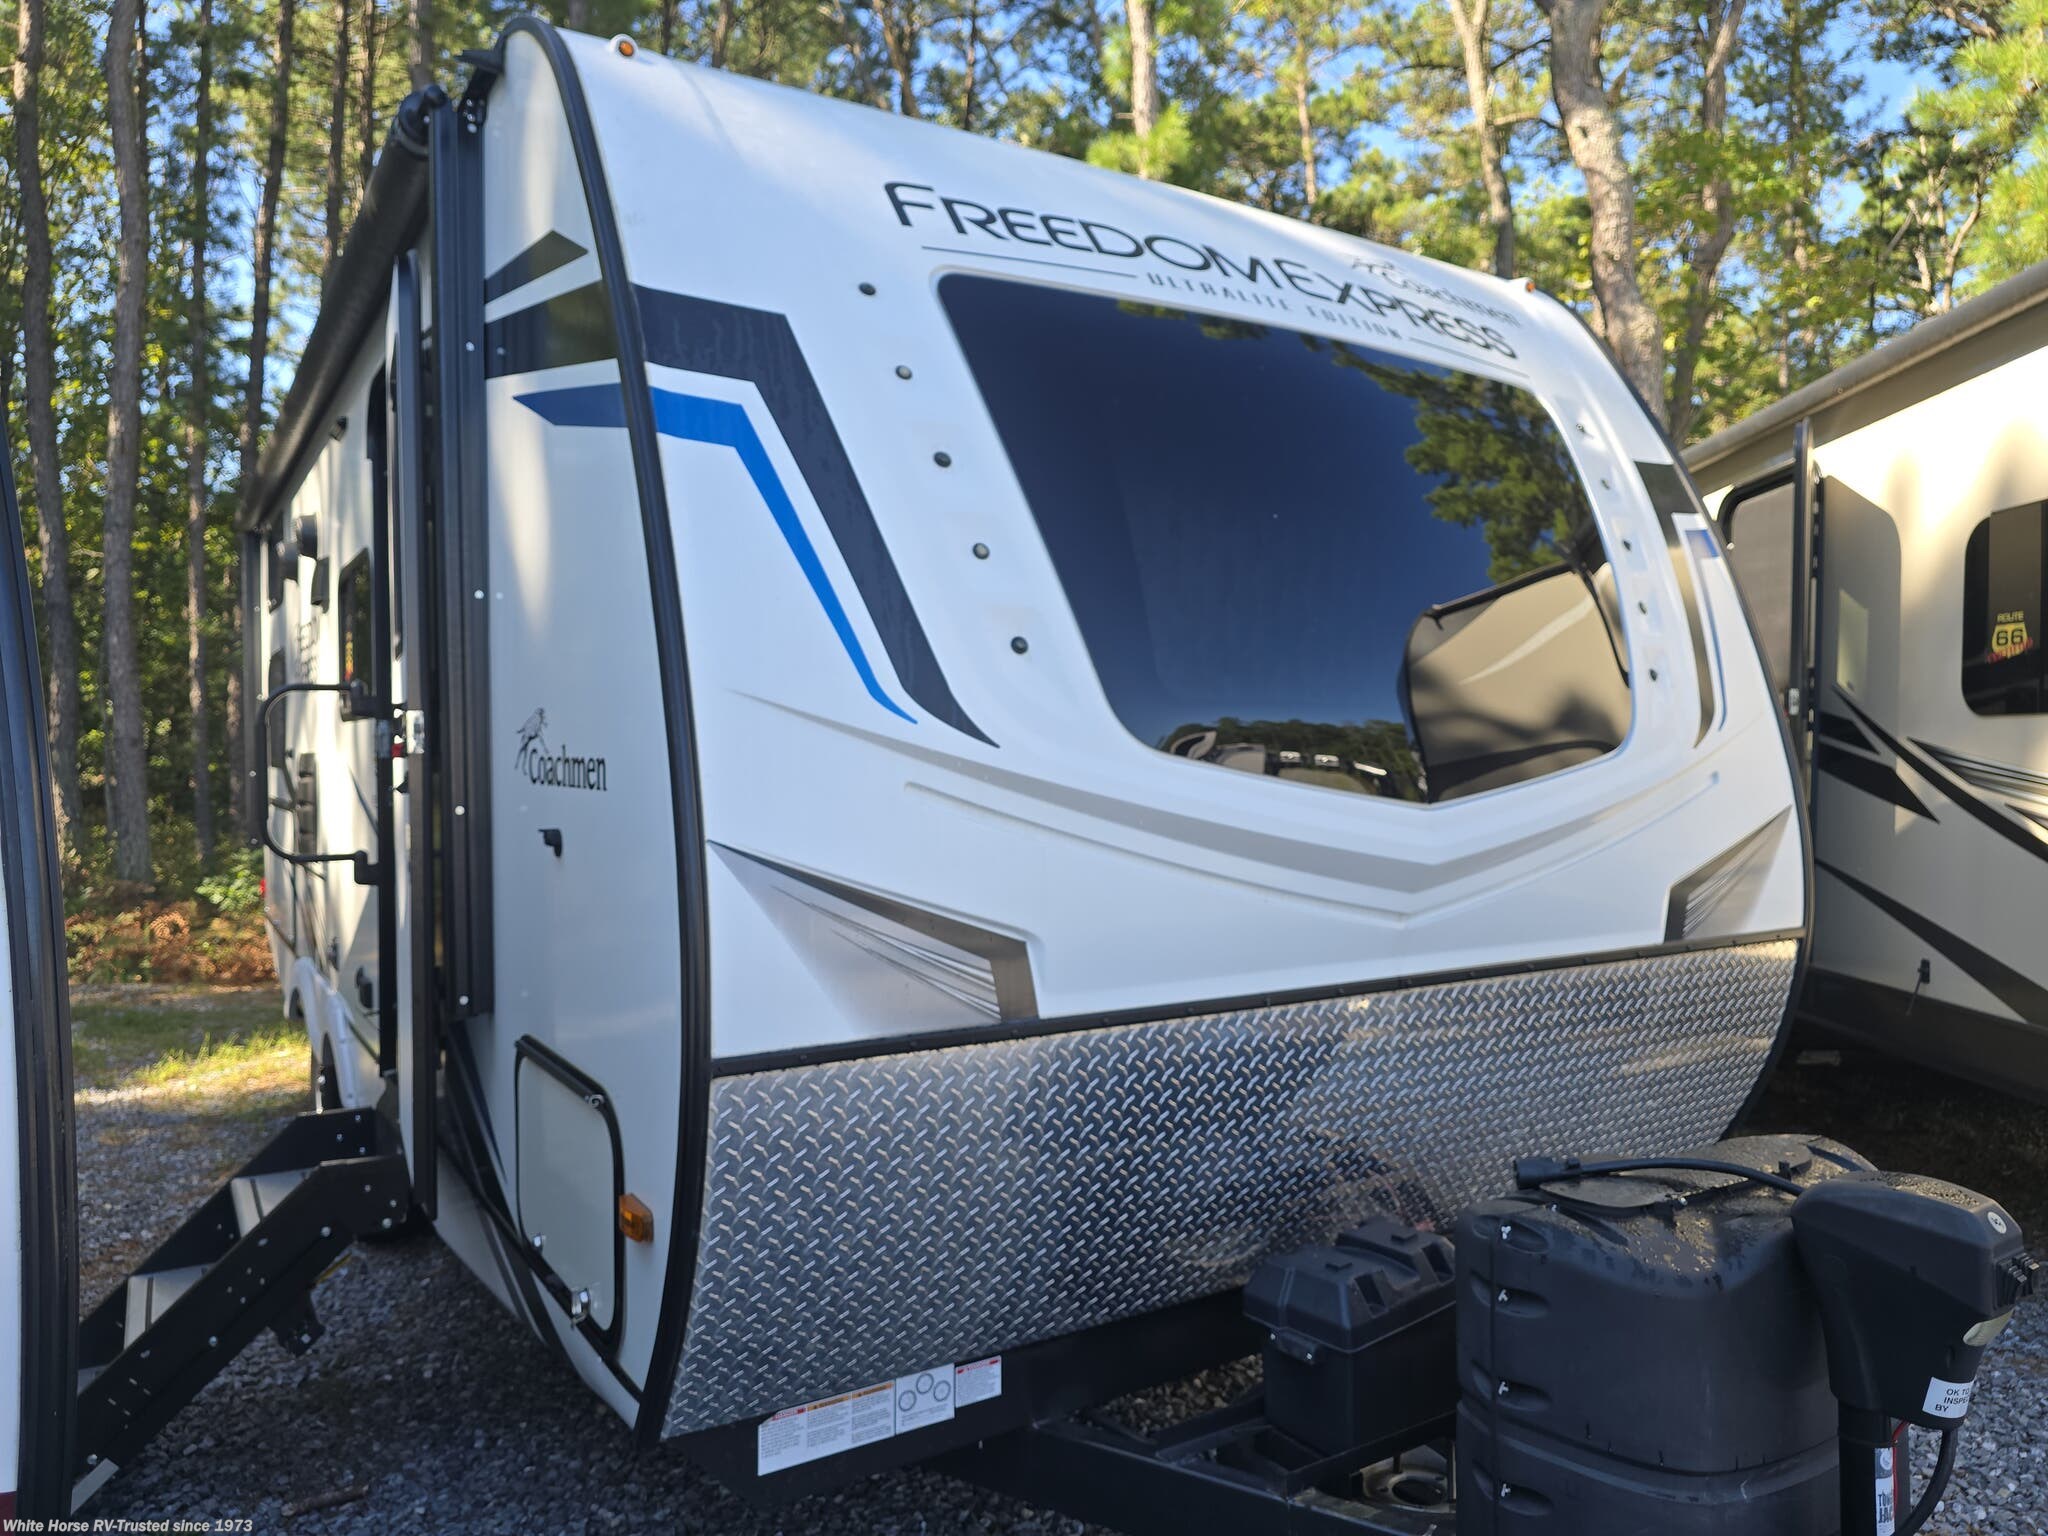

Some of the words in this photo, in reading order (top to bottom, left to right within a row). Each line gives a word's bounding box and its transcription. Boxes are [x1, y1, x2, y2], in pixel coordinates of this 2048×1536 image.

[1995, 628, 2024, 647] 66
[528, 743, 608, 792] Coachmen
[1946, 1388, 1960, 1396] OK
[1935, 1403, 1949, 1412] BY
